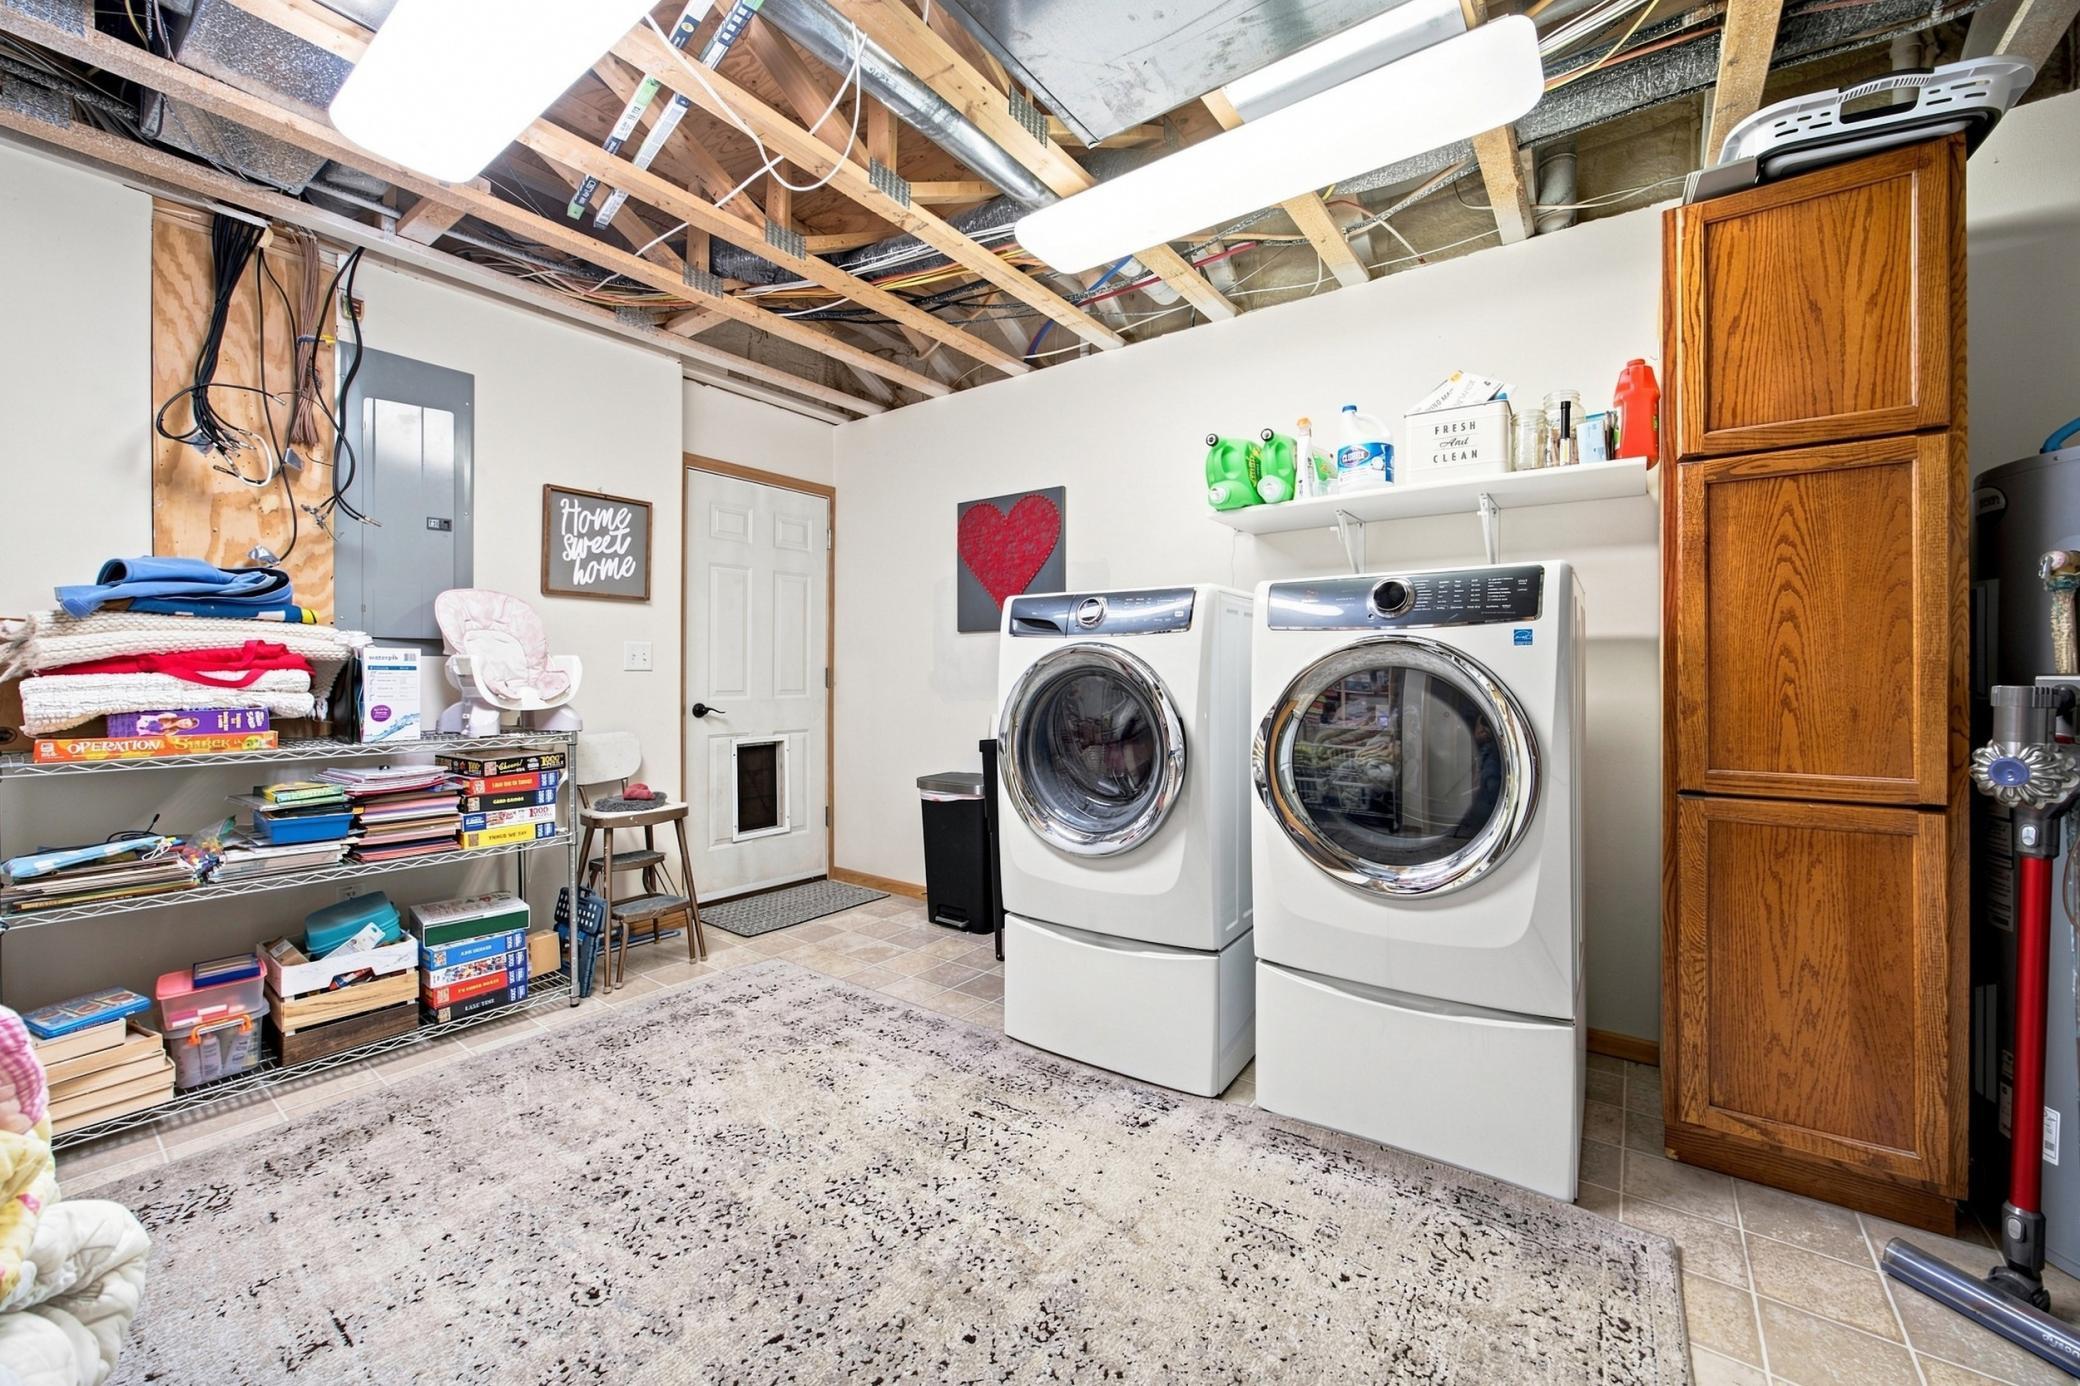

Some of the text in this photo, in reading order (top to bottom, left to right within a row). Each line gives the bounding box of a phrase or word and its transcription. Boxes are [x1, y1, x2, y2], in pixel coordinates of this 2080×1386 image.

[1434, 421, 1476, 435] FRESH
[1433, 449, 1478, 463] CLEAN
[560, 498, 632, 536] Home
[562, 528, 631, 561] sweet
[573, 555, 636, 586] home
[66, 739, 161, 755] OPERATION
